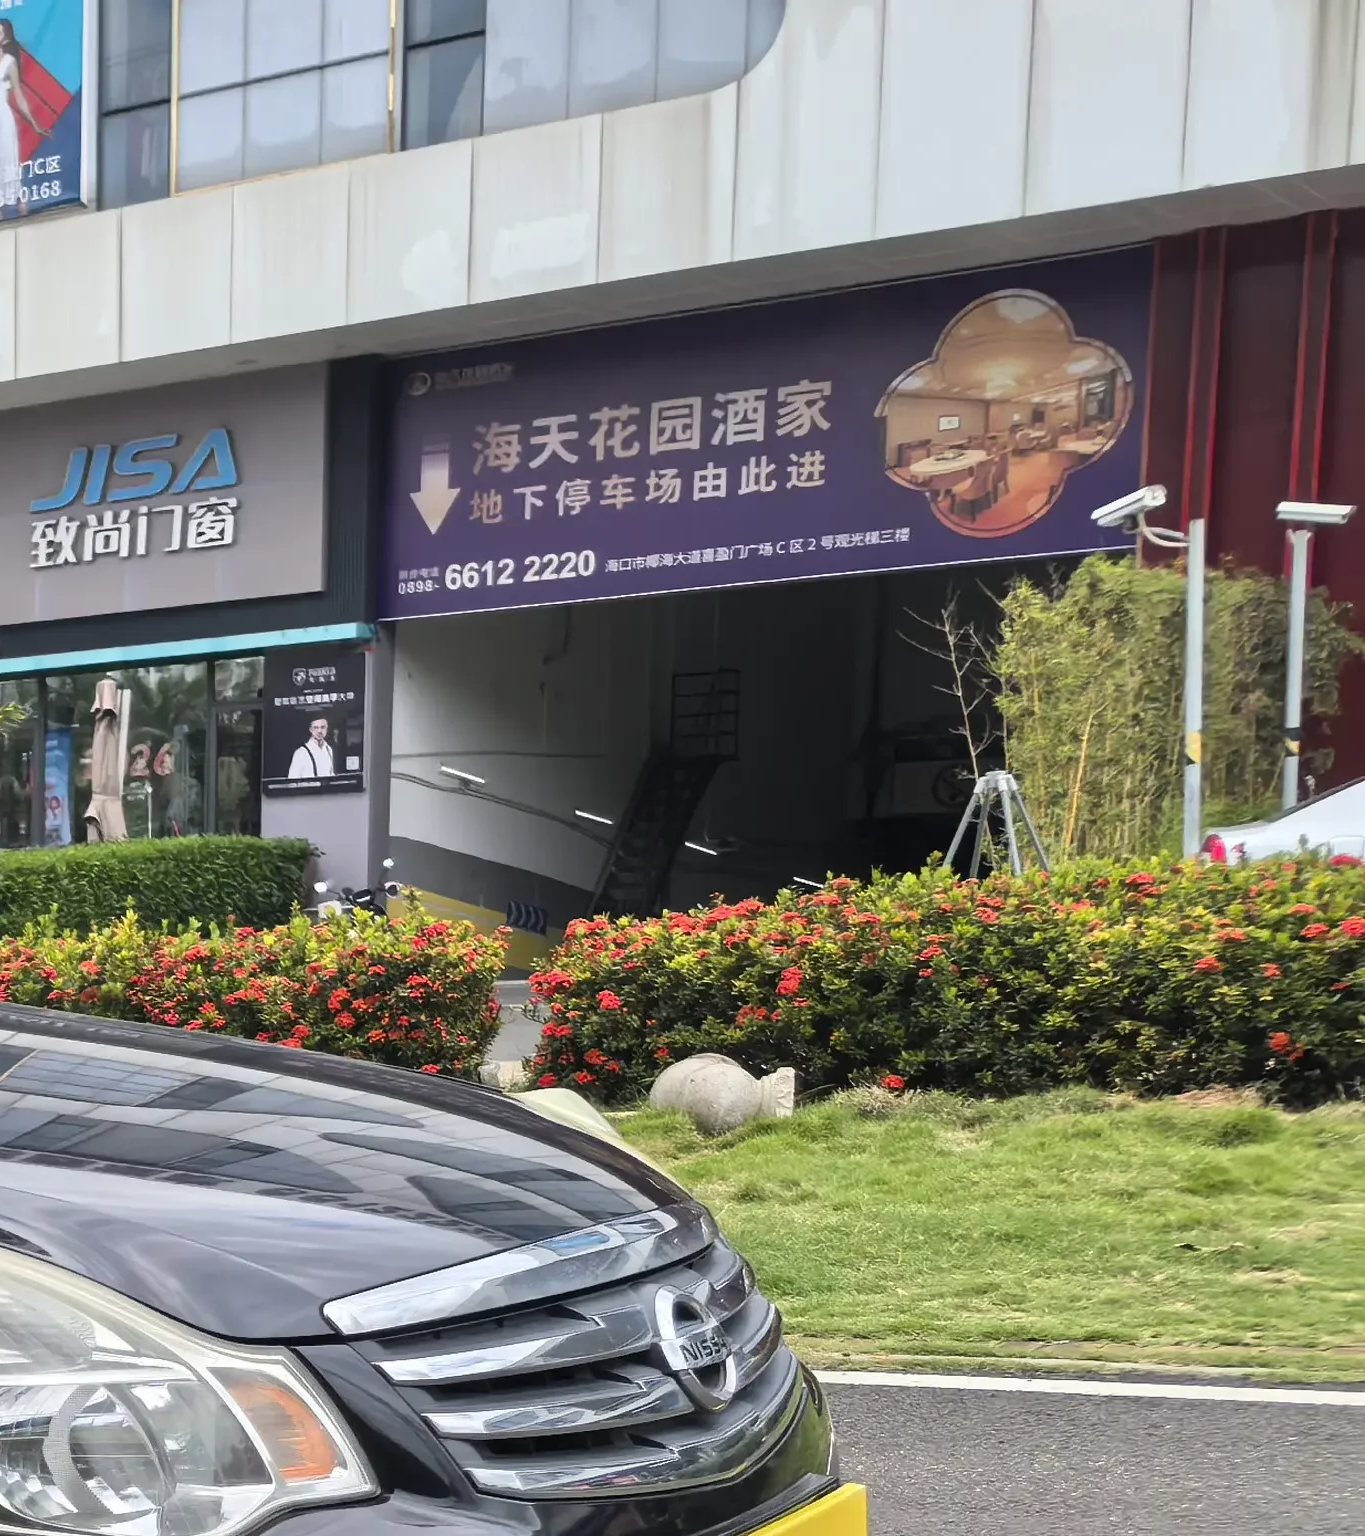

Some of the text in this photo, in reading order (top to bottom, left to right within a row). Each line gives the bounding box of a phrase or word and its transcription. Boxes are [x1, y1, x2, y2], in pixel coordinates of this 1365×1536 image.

[472, 379, 833, 476] 海天花园酒家
[30, 428, 238, 512] JISA
[469, 450, 826, 524] 地下停车场由此进
[29, 497, 238, 568] 致尚门窗
[444, 558, 515, 590] 6612
[522, 550, 596, 582] 2220
